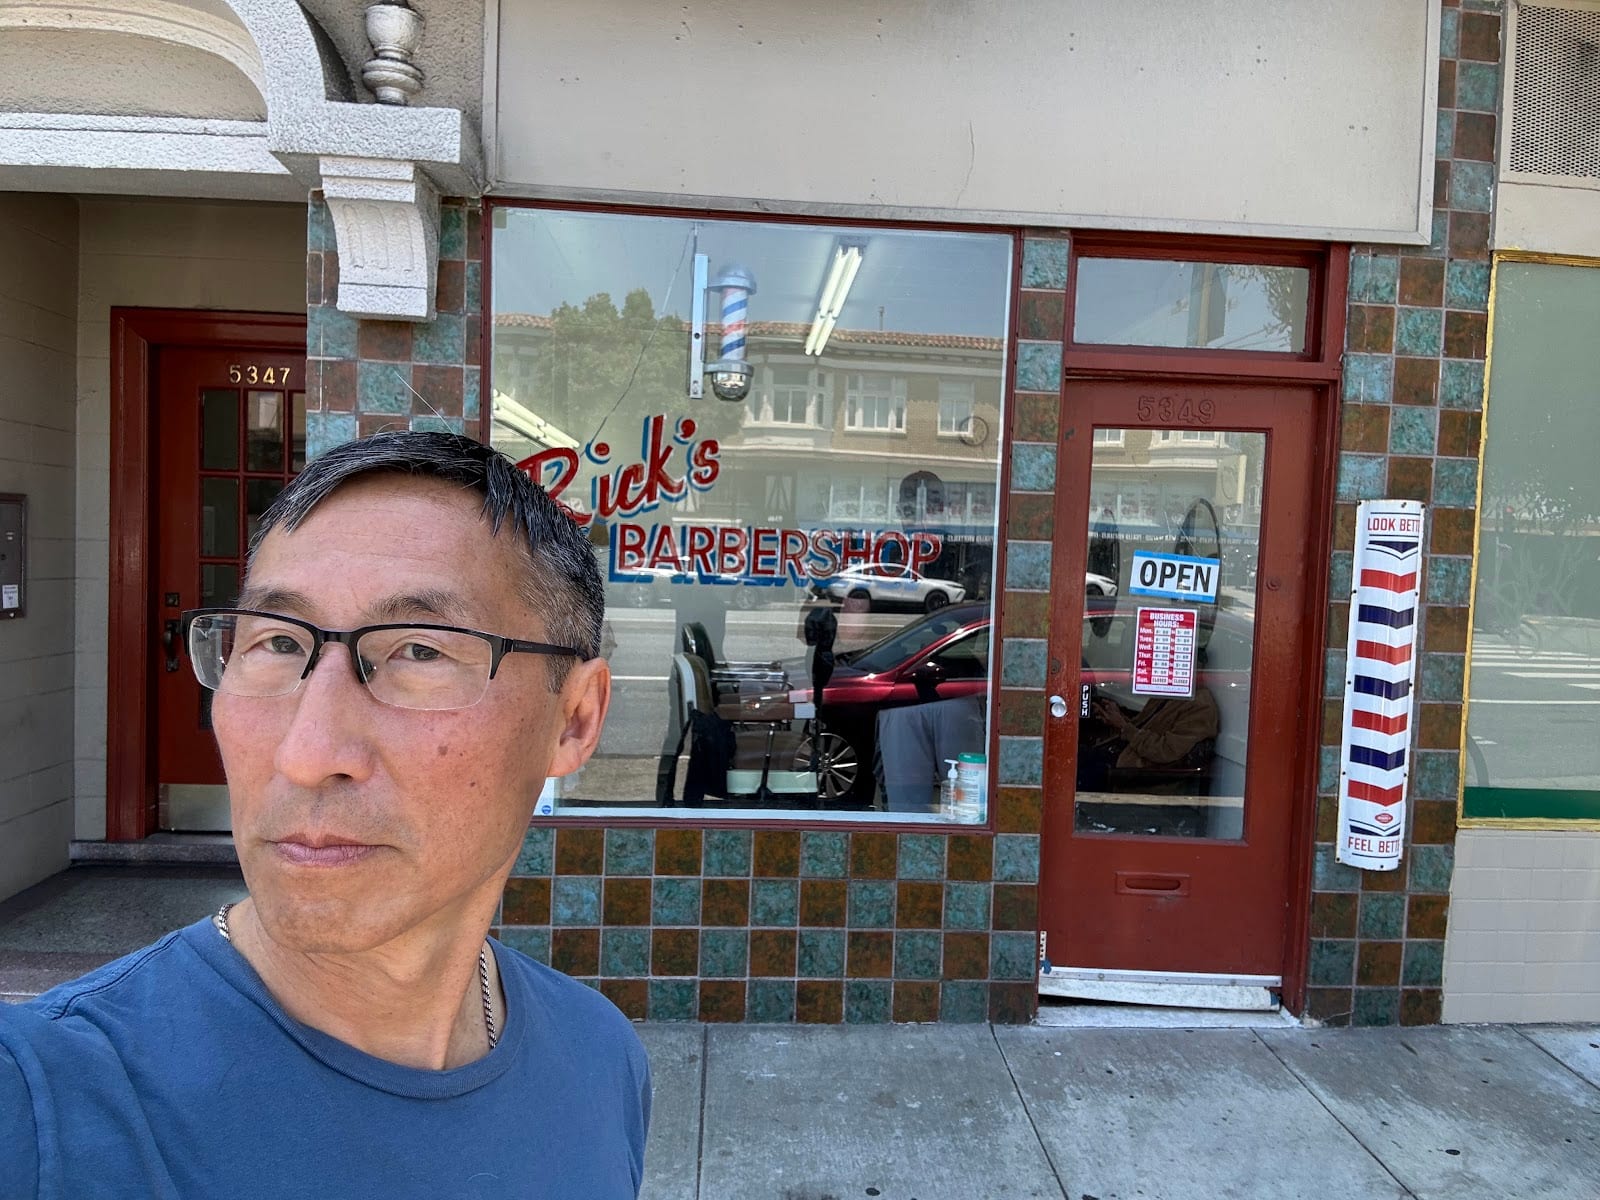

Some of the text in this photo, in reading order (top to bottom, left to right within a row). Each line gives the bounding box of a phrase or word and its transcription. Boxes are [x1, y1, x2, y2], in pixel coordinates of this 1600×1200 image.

[229, 365, 291, 386] 5347
[1137, 394, 1216, 424] 5349
[514, 413, 721, 529] Rick's
[1367, 517, 1396, 532] LOOK
[612, 523, 943, 583] BARBERSHOP
[1139, 560, 1212, 593] OPEN
[1149, 612, 1185, 622] BUSINESS
[1081, 684, 1090, 717] PUSH
[1347, 836, 1374, 853] FEEL
